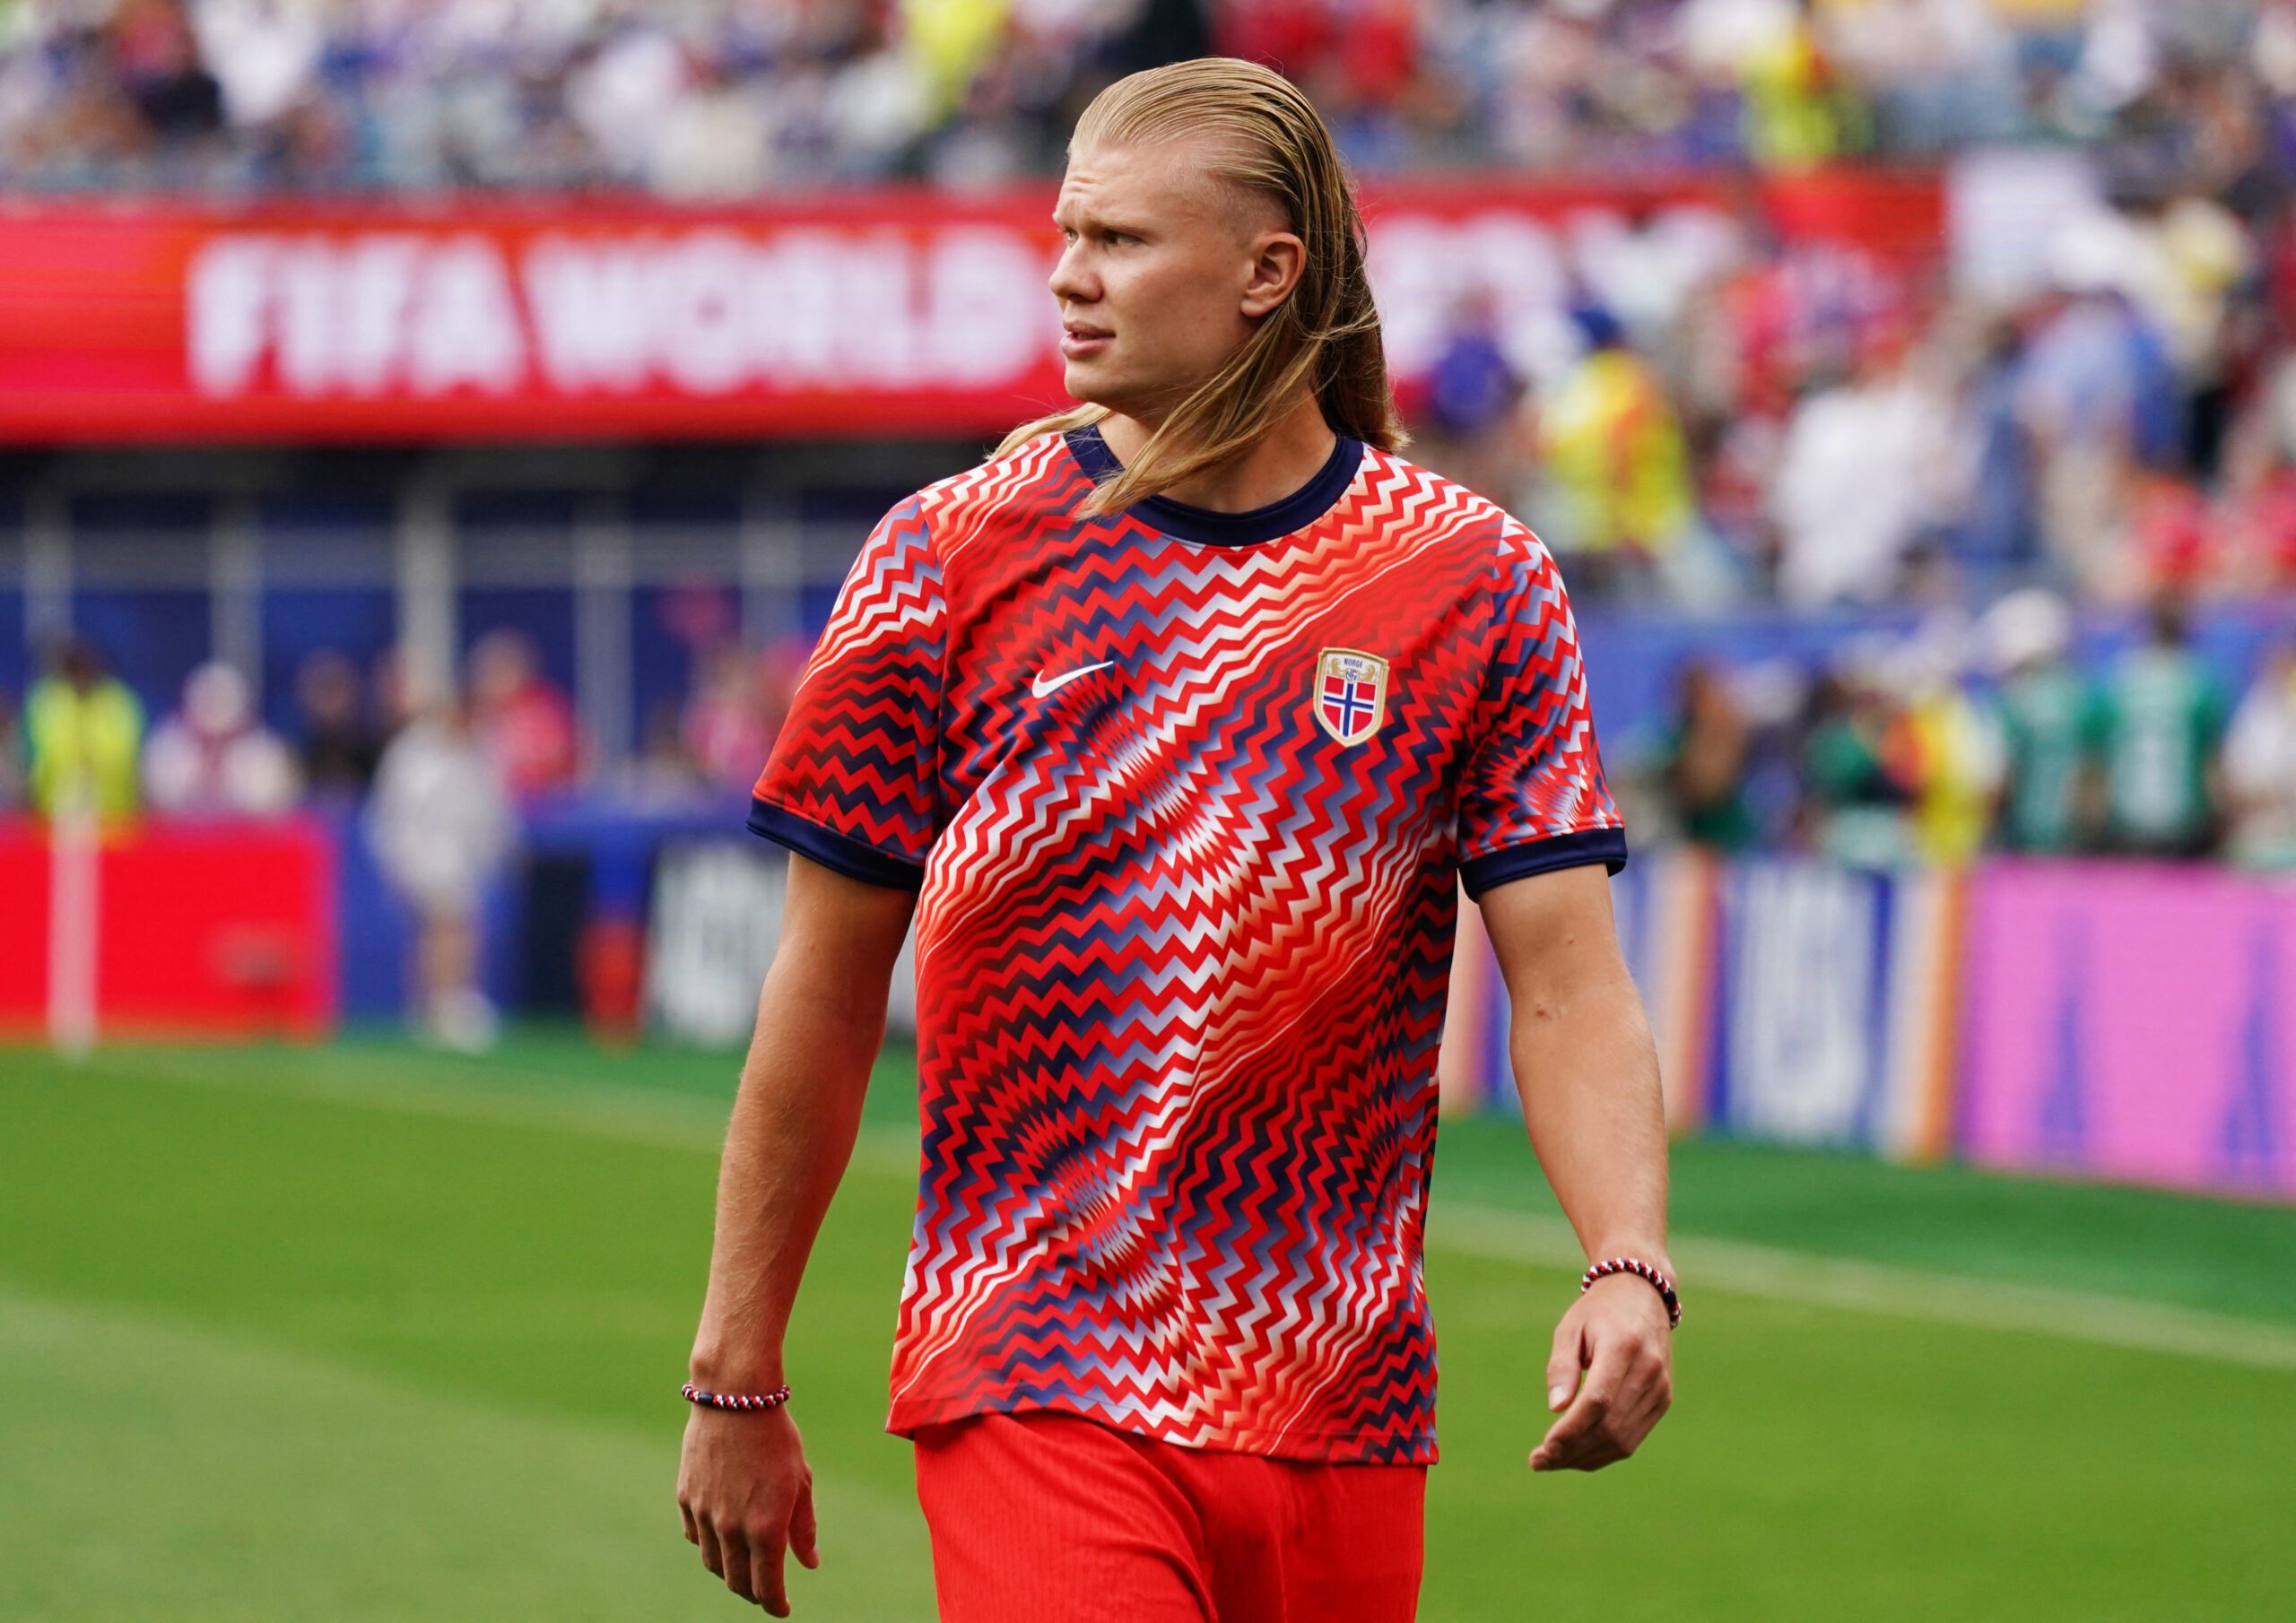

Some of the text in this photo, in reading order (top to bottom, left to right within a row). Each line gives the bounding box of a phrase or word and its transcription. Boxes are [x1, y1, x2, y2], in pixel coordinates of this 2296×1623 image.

[187, 224, 1037, 398] FIFA WORLD
[1344, 657, 1363, 668] NORGE
